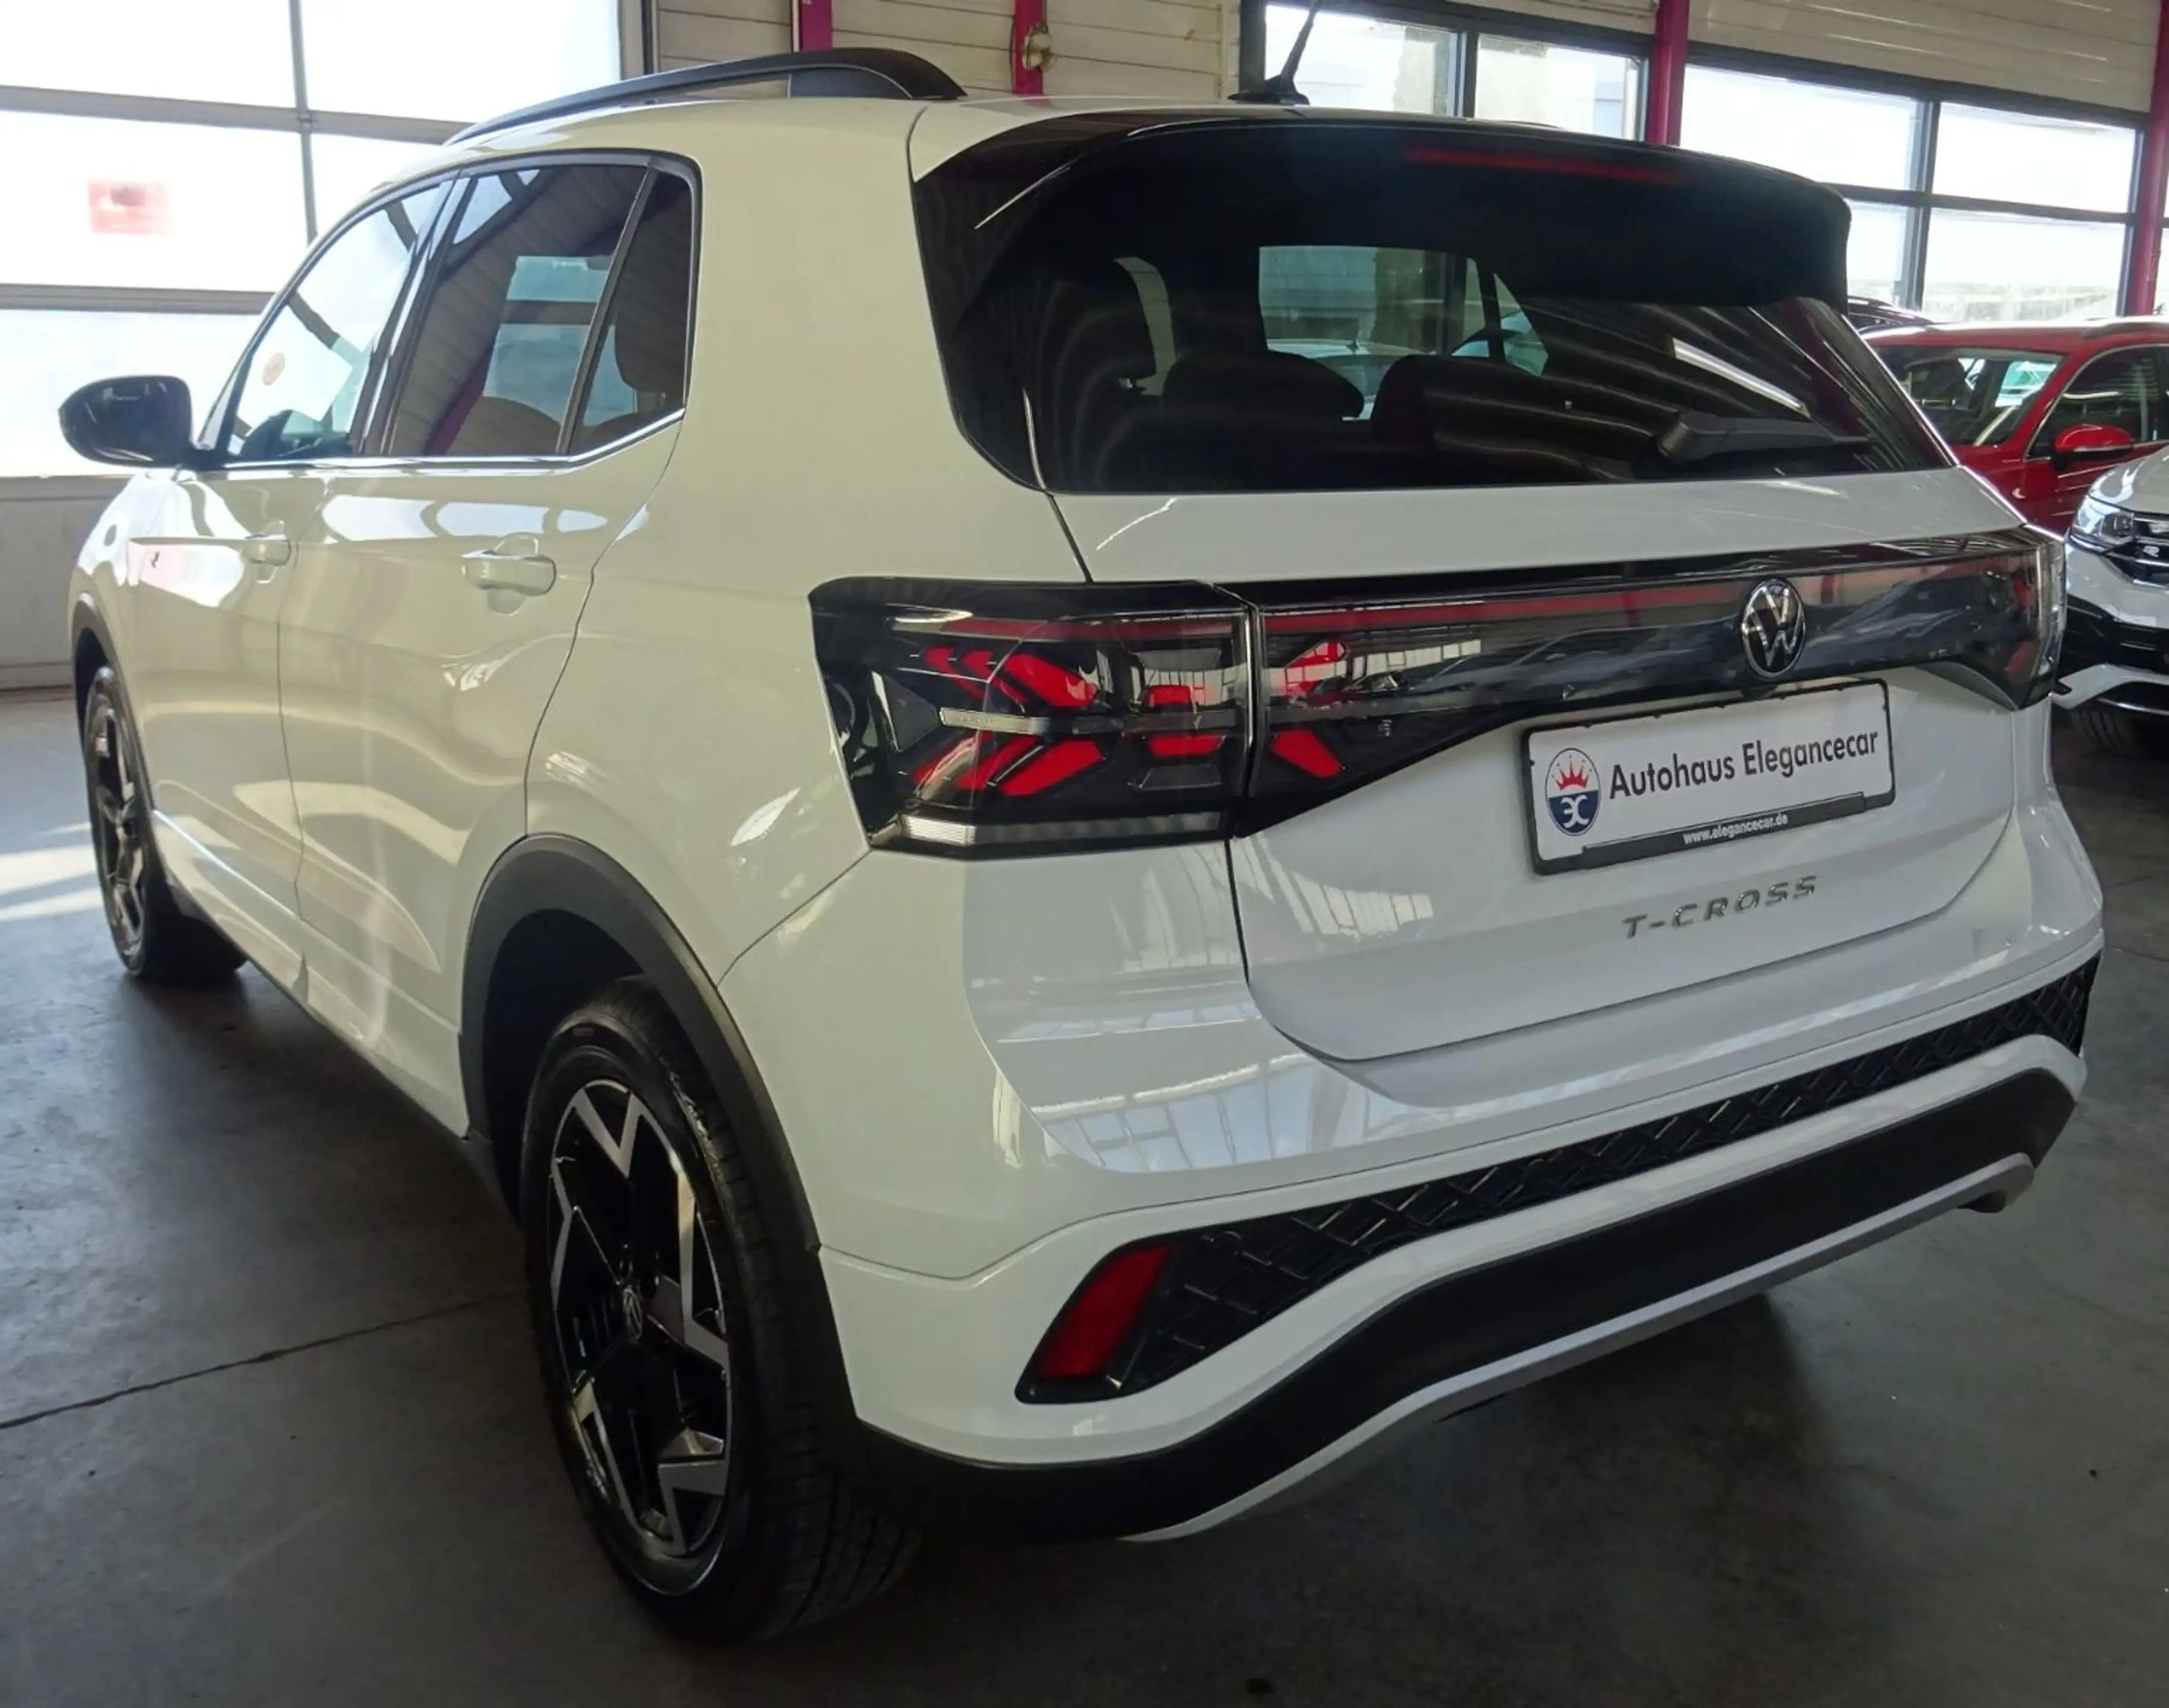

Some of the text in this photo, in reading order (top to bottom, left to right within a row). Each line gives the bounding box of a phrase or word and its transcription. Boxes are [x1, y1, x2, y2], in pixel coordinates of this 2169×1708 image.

[1609, 731, 1878, 799] Autohaus Elegancecar
[1683, 812, 1788, 845] www.elegancecar.de
[1622, 875, 1817, 939] T-CROSS
